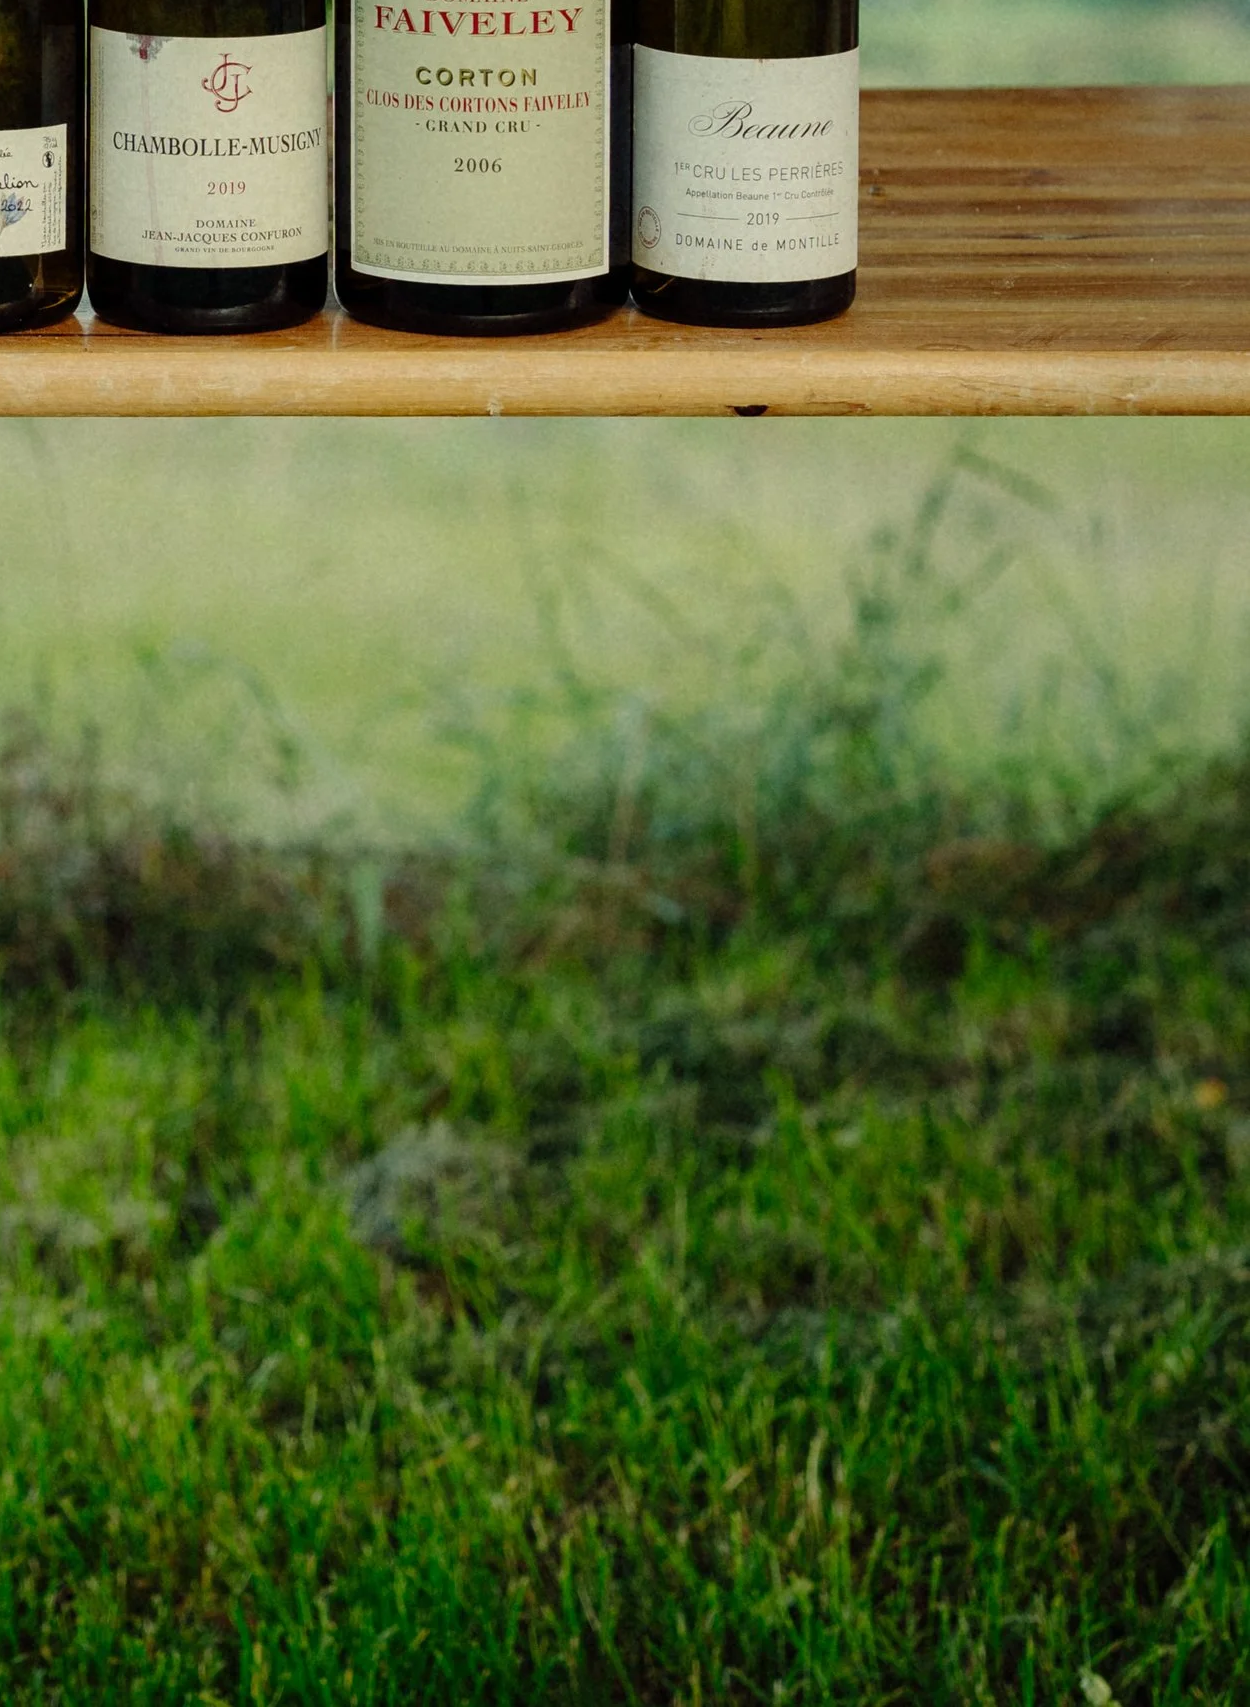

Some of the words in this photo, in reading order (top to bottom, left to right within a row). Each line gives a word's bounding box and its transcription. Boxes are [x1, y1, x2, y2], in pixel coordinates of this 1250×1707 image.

[374, 4, 583, 37] FAIVELEY
[415, 66, 538, 87] CORTON
[367, 88, 400, 108] CLOS
[404, 94, 435, 111] DES
[439, 96, 518, 113] CORTONS
[524, 91, 591, 112] FAIVELEY
[426, 119, 488, 134] GRAND
[495, 120, 531, 134] CRU
[688, 100, 834, 140] Beaune
[113, 128, 322, 156] CHAMBOLLE-MUSIGNY
[454, 158, 503, 173] 2006
[675, 162, 691, 176] 1ER
[693, 164, 726, 180] CRU
[731, 167, 762, 182] LES
[207, 181, 246, 195] 2019
[685, 188, 733, 201] Appellation
[736, 191, 769, 201] Beaune
[784, 191, 799, 200] Cru
[1, 198, 33, 212] 2022
[196, 218, 256, 228] DOMAINE
[747, 212, 780, 226] 2019
[141, 230, 237, 245] JEAN-JACQUES
[240, 227, 302, 242] CONFURON
[675, 233, 743, 251] DOMAINE
[751, 241, 768, 251] de
[776, 233, 839, 251] MONTILLE
[231, 245, 275, 253] BOURGOGNE
[398, 242, 437, 252] BOUTEILLE
[439, 245, 450, 253] AU
[452, 245, 492, 254] DOMAINE
